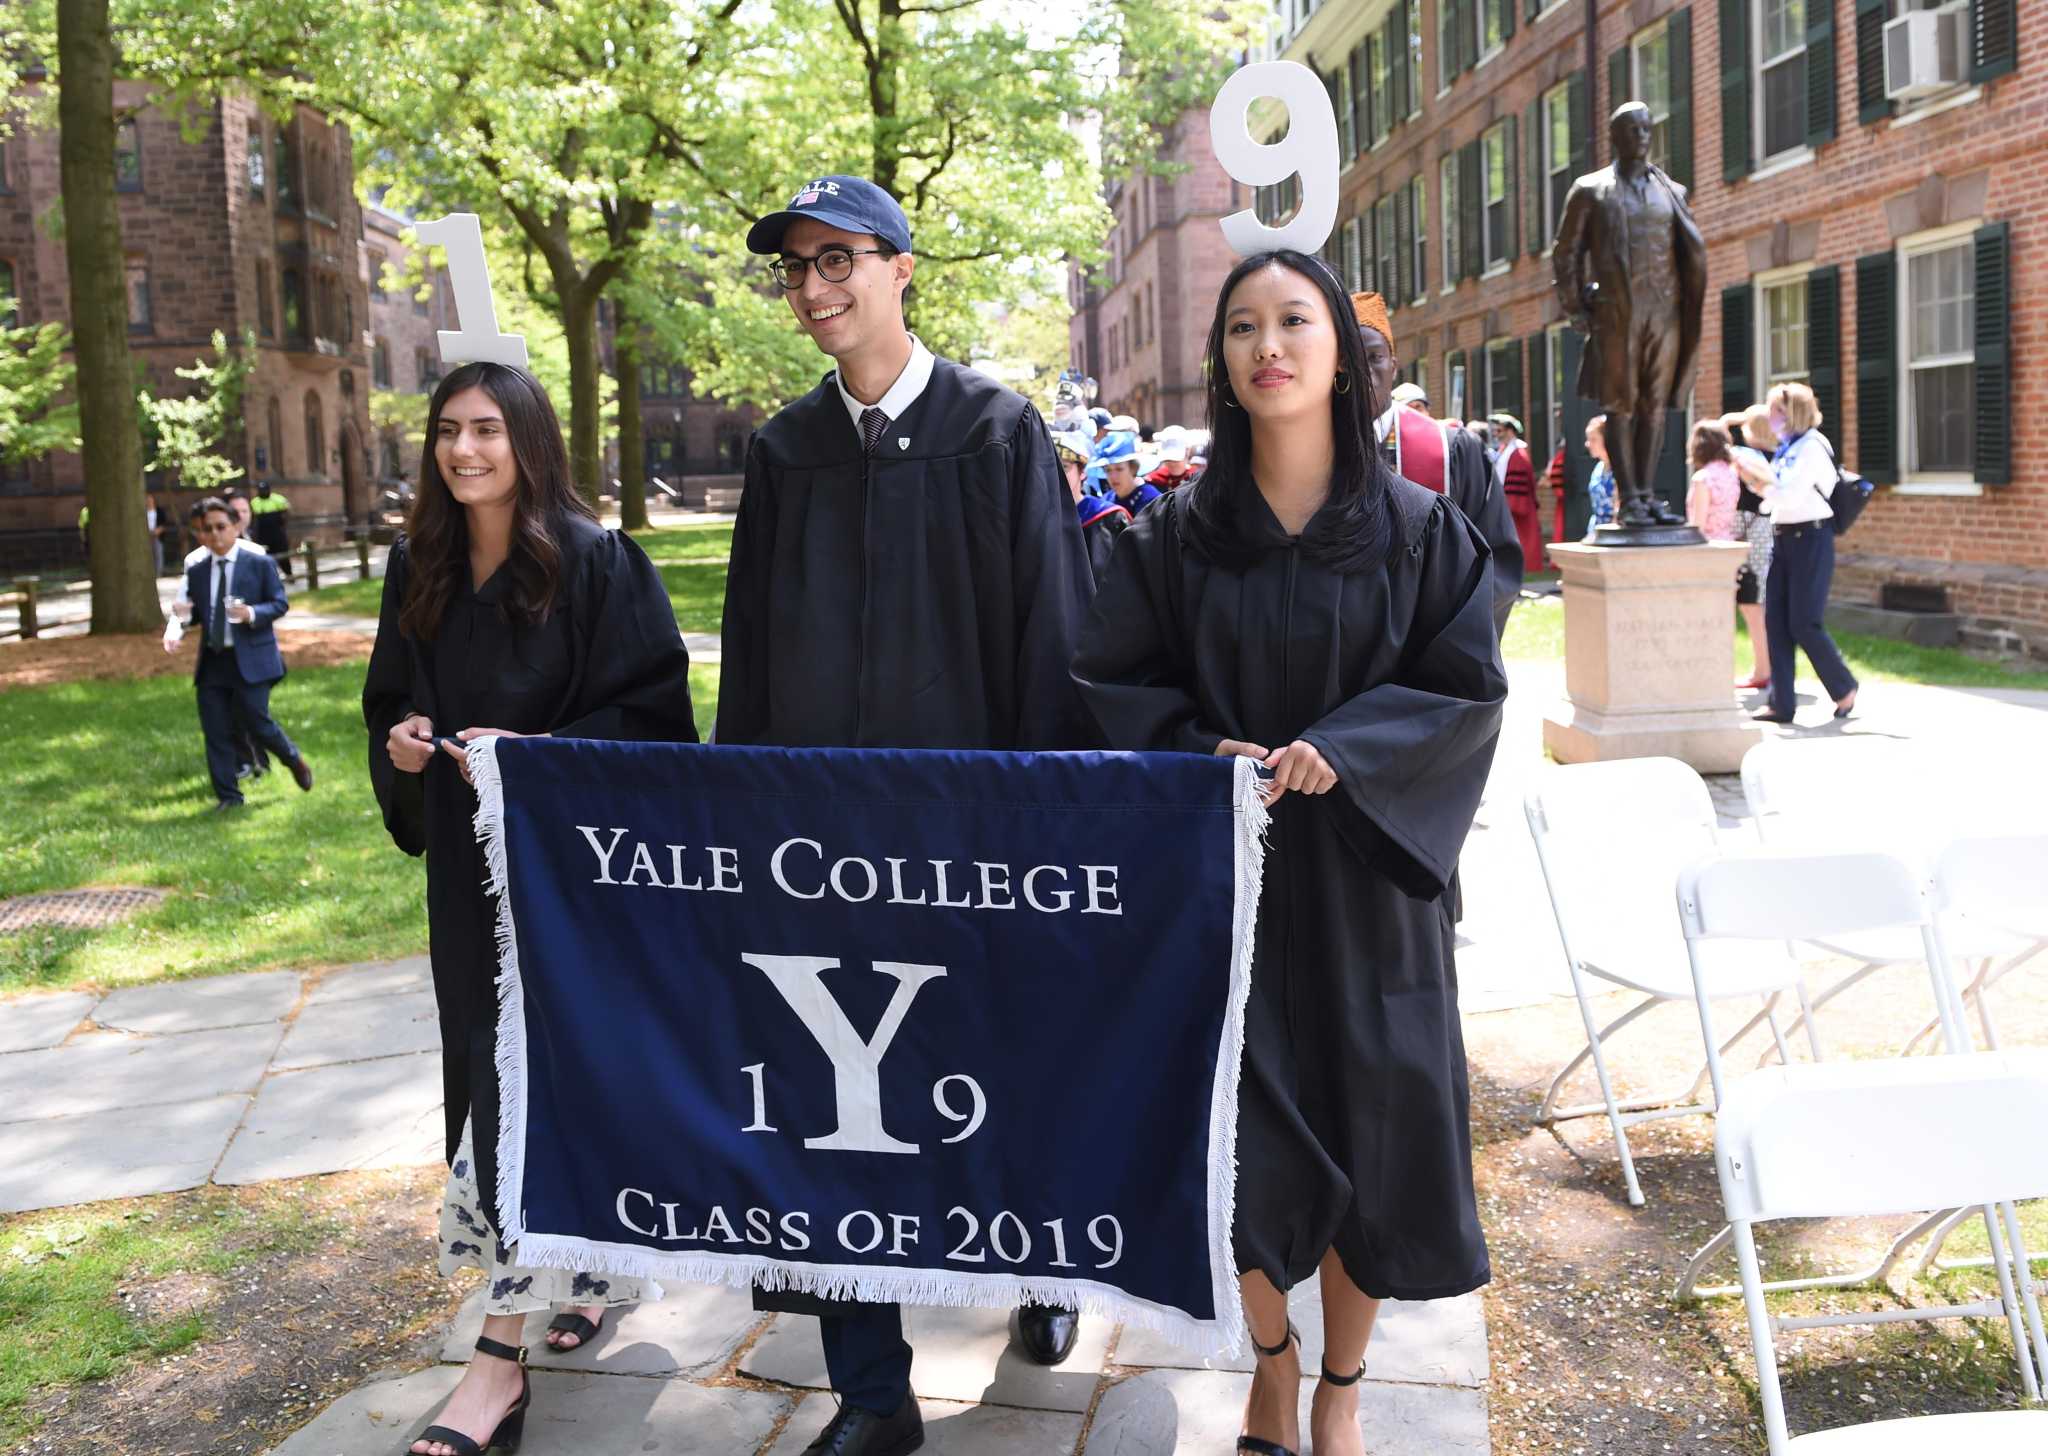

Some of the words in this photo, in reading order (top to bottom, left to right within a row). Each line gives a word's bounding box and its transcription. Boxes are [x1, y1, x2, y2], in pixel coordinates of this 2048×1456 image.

[1209, 59, 1341, 256] 9
[413, 212, 529, 367] 1
[575, 825, 743, 893] YALE
[771, 837, 1123, 916] COLLEGE
[741, 951, 948, 1154] Y
[741, 1062, 778, 1133] 1
[932, 1073, 987, 1144] 9
[615, 1187, 811, 1252] CLASS
[837, 1210, 921, 1257] OF
[945, 1205, 1124, 1269] 2019
